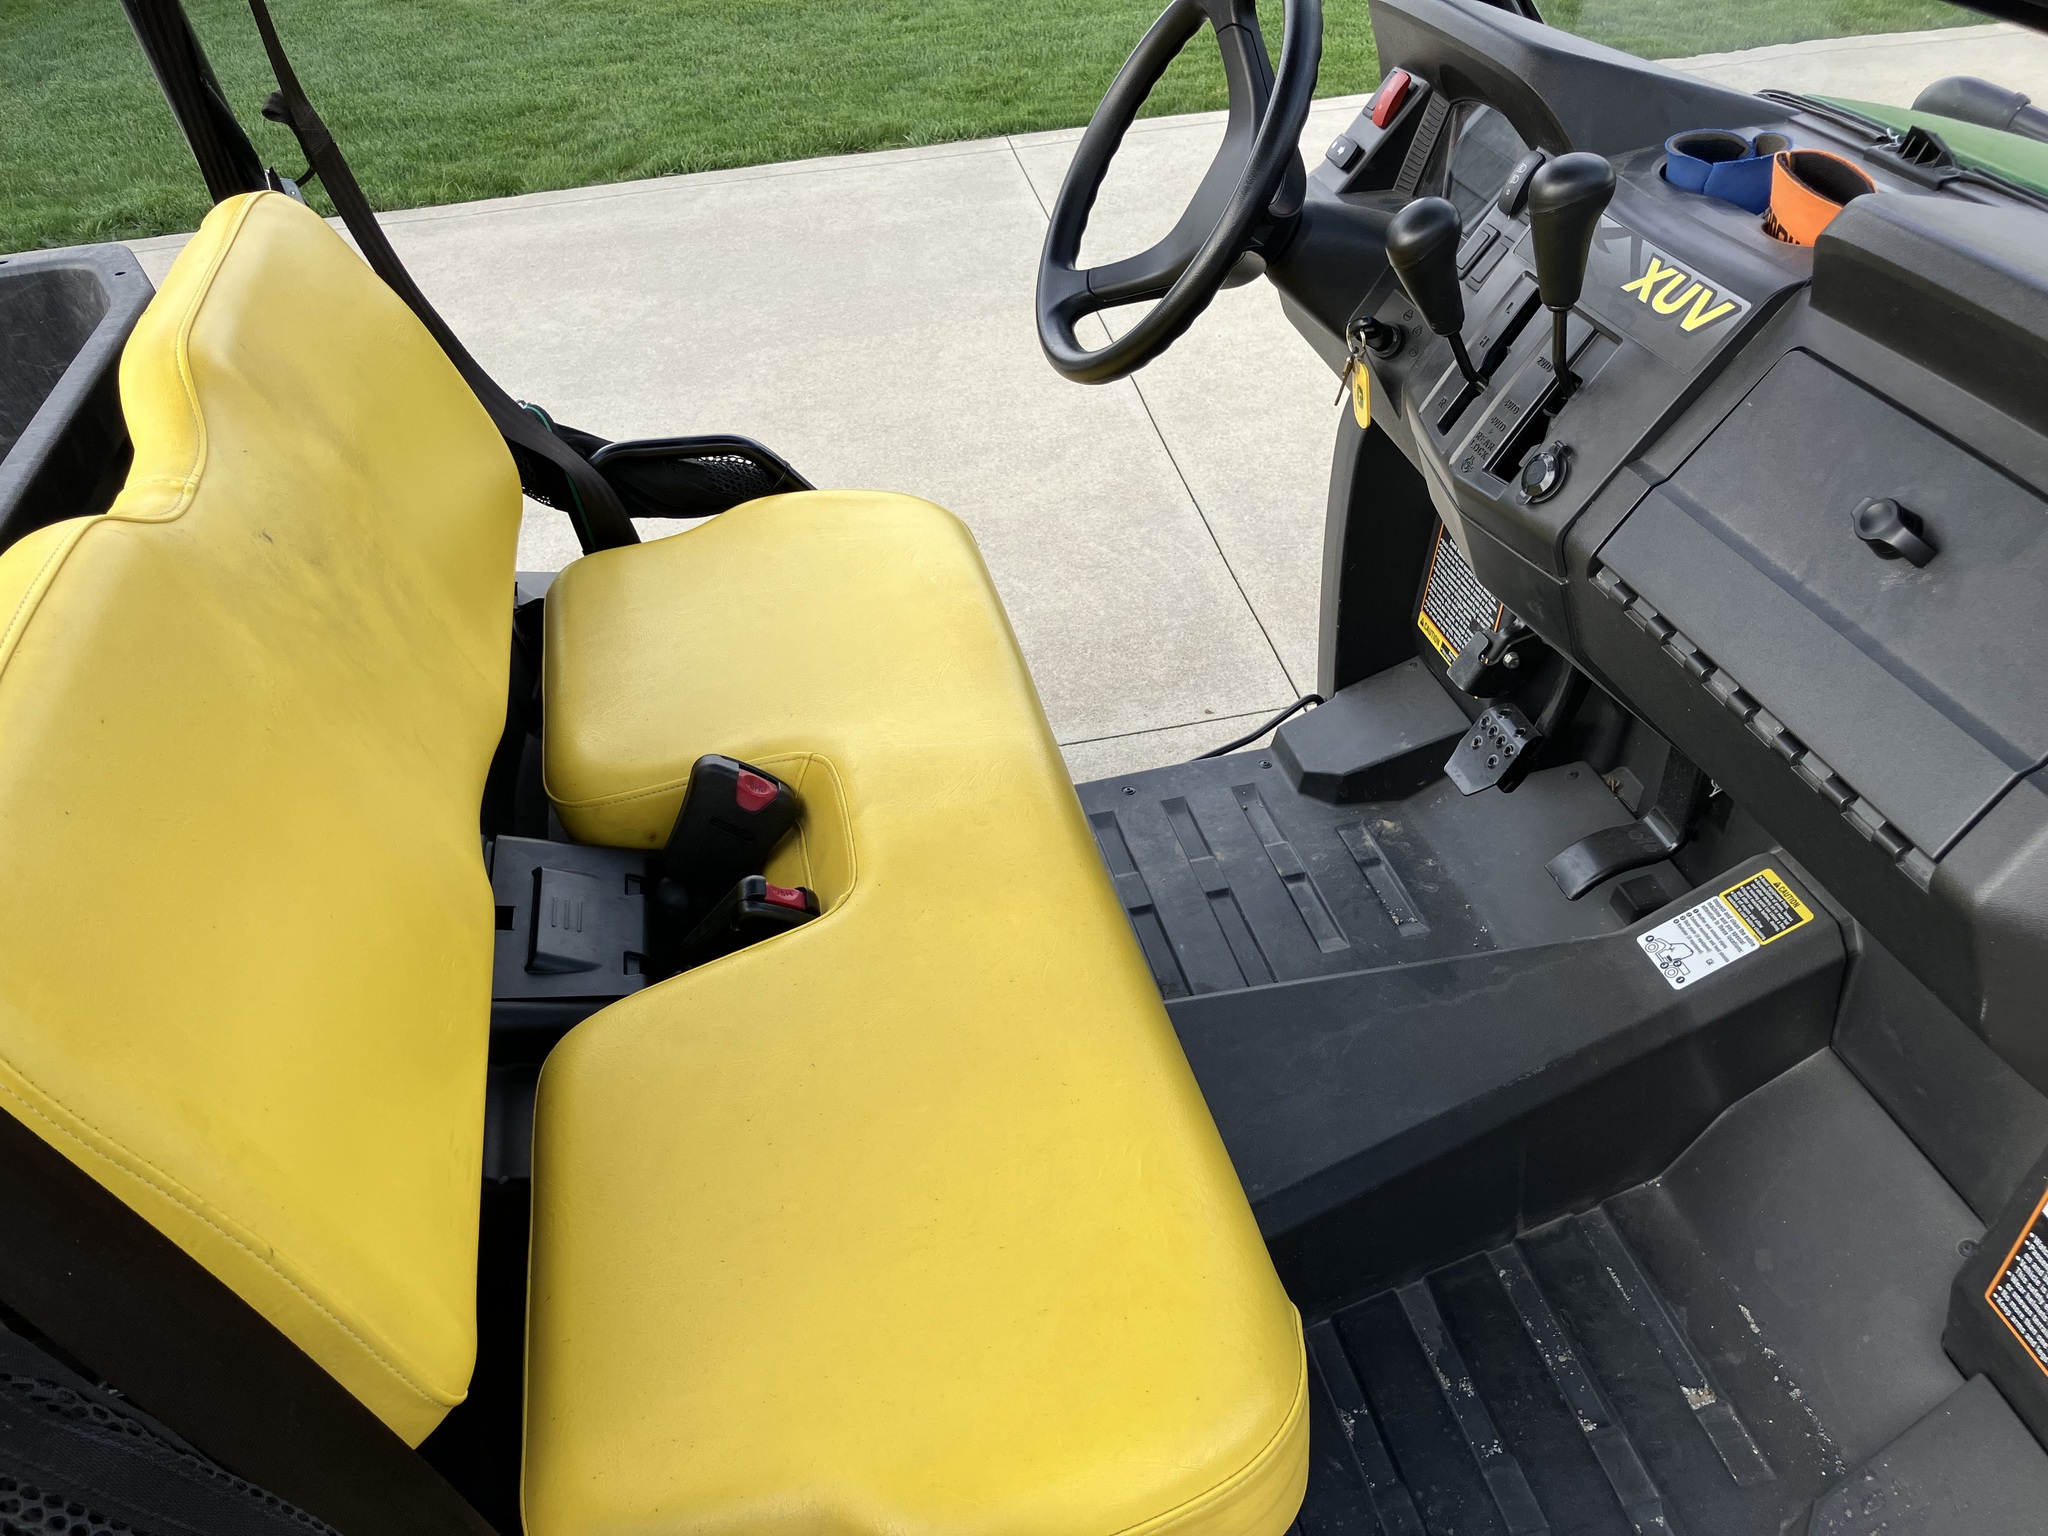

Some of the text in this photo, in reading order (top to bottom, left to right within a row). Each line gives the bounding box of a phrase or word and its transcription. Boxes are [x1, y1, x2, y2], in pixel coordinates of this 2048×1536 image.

[1620, 257, 1736, 332] XUV
[1536, 356, 1554, 373] 2WD
[1503, 398, 1520, 415] 4WD
[1490, 416, 1507, 432] 4WD
[1468, 439, 1489, 460] LOCK
[1475, 431, 1496, 450] REAR
[1777, 885, 1800, 907] CAUTION
[1700, 904, 1717, 921] attention
[1717, 924, 1729, 935] these
[1706, 901, 1746, 945] machine and pay special
[1711, 898, 1726, 912] Inspect
[1723, 911, 1733, 919] and
[1729, 918, 1741, 929] clean
[1743, 934, 1756, 946] entire
[2019, 1258, 2040, 1287] Vehicle
[2032, 1260, 2043, 1276] and
[2005, 1282, 2012, 1293] or
[2012, 1290, 2032, 1317] uneven
[2010, 1273, 2048, 1322] Wear helmets
[2014, 1266, 2027, 1284] This
[2026, 1280, 2044, 1306] safety
[1996, 1296, 2011, 1317] Keep
[2010, 1314, 2025, 1334] arms
[2025, 1331, 2036, 1347] and
[2001, 1288, 2048, 1349] No more than one
